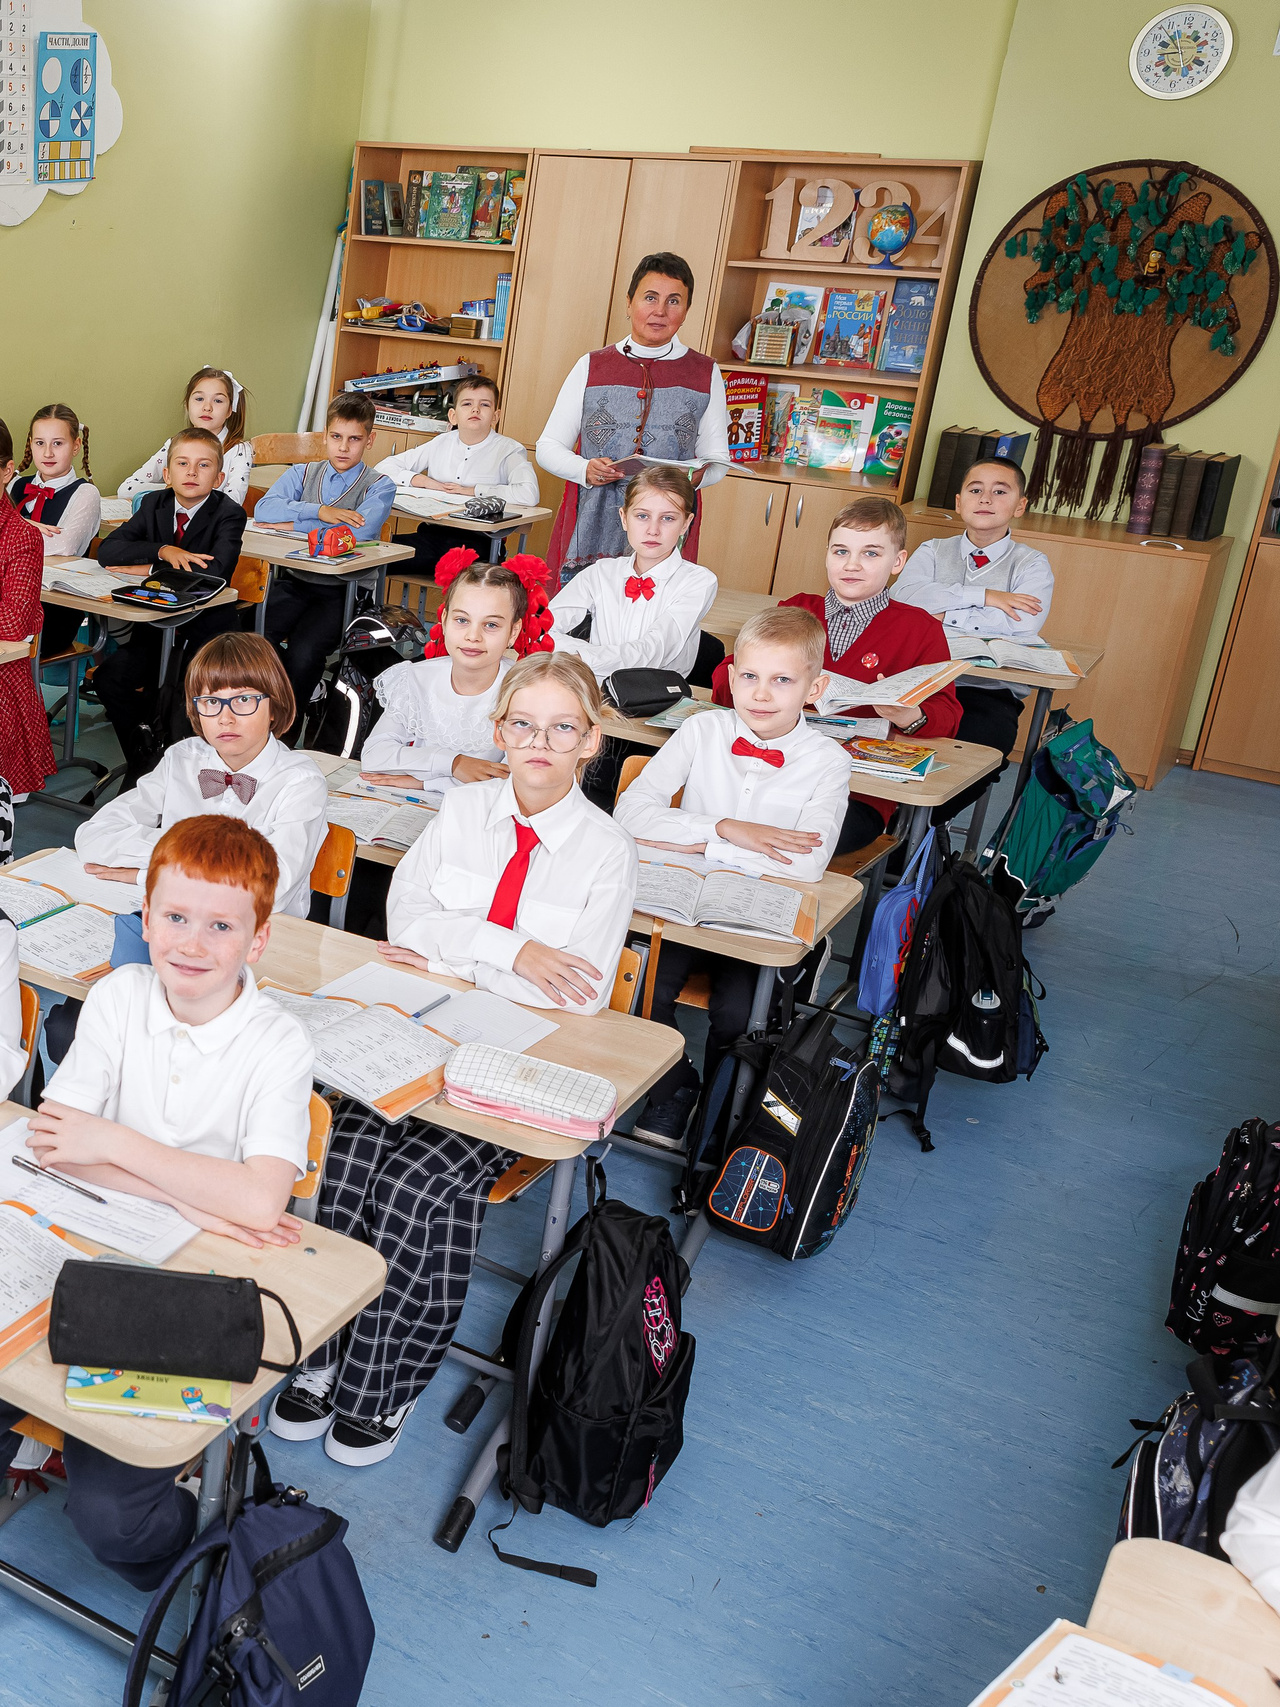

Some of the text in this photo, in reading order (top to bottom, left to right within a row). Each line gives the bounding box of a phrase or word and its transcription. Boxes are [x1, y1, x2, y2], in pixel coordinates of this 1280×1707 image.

[9, 2, 13, 11] 1
[1184, 16, 1194, 25] 12
[9, 22, 14, 31] 2
[1167, 22, 1174, 30] 11
[72, 37, 89, 47] ДОЛИ
[1152, 33, 1161, 44] 10
[9, 42, 13, 51] 3
[1143, 49, 1150, 57] 9
[9, 63, 13, 71] 4
[9, 82, 13, 91] 5
[1170, 80, 1177, 88] 6
[9, 103, 12, 111] 6
[8, 122, 12, 131] 7
[8, 142, 11, 150] 8
[6, 161, 10, 170] 9
[832, 311, 874, 321] РОССИИ
[729, 378, 758, 388] ПРАВИЛА
[728, 394, 758, 402] ДВИЖЕНИЯ
[885, 402, 914, 411] Дорожн
[884, 410, 913, 419] безопас
